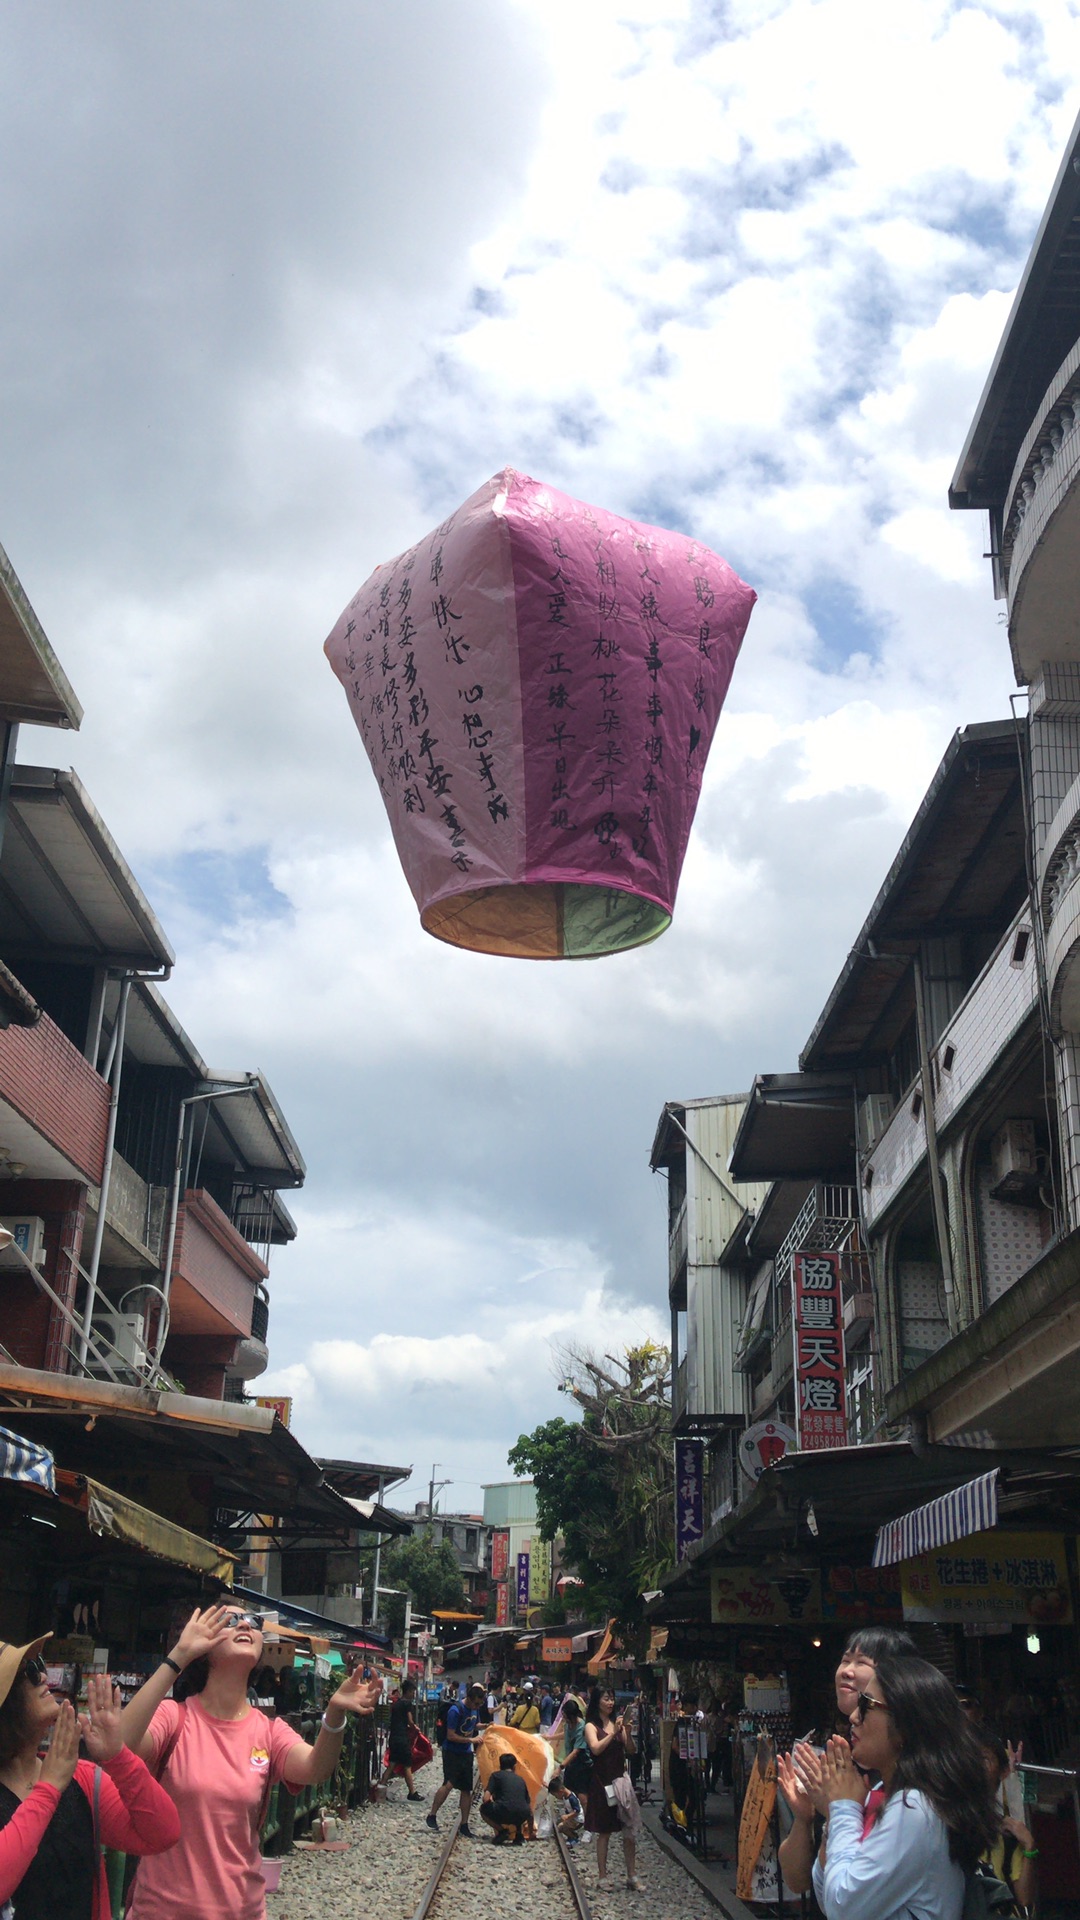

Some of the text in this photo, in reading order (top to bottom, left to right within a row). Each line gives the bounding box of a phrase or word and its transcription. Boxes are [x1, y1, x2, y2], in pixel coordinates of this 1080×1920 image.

[798, 1257, 838, 1412] 協豐天燈
[802, 1414, 845, 1434] 批發零售
